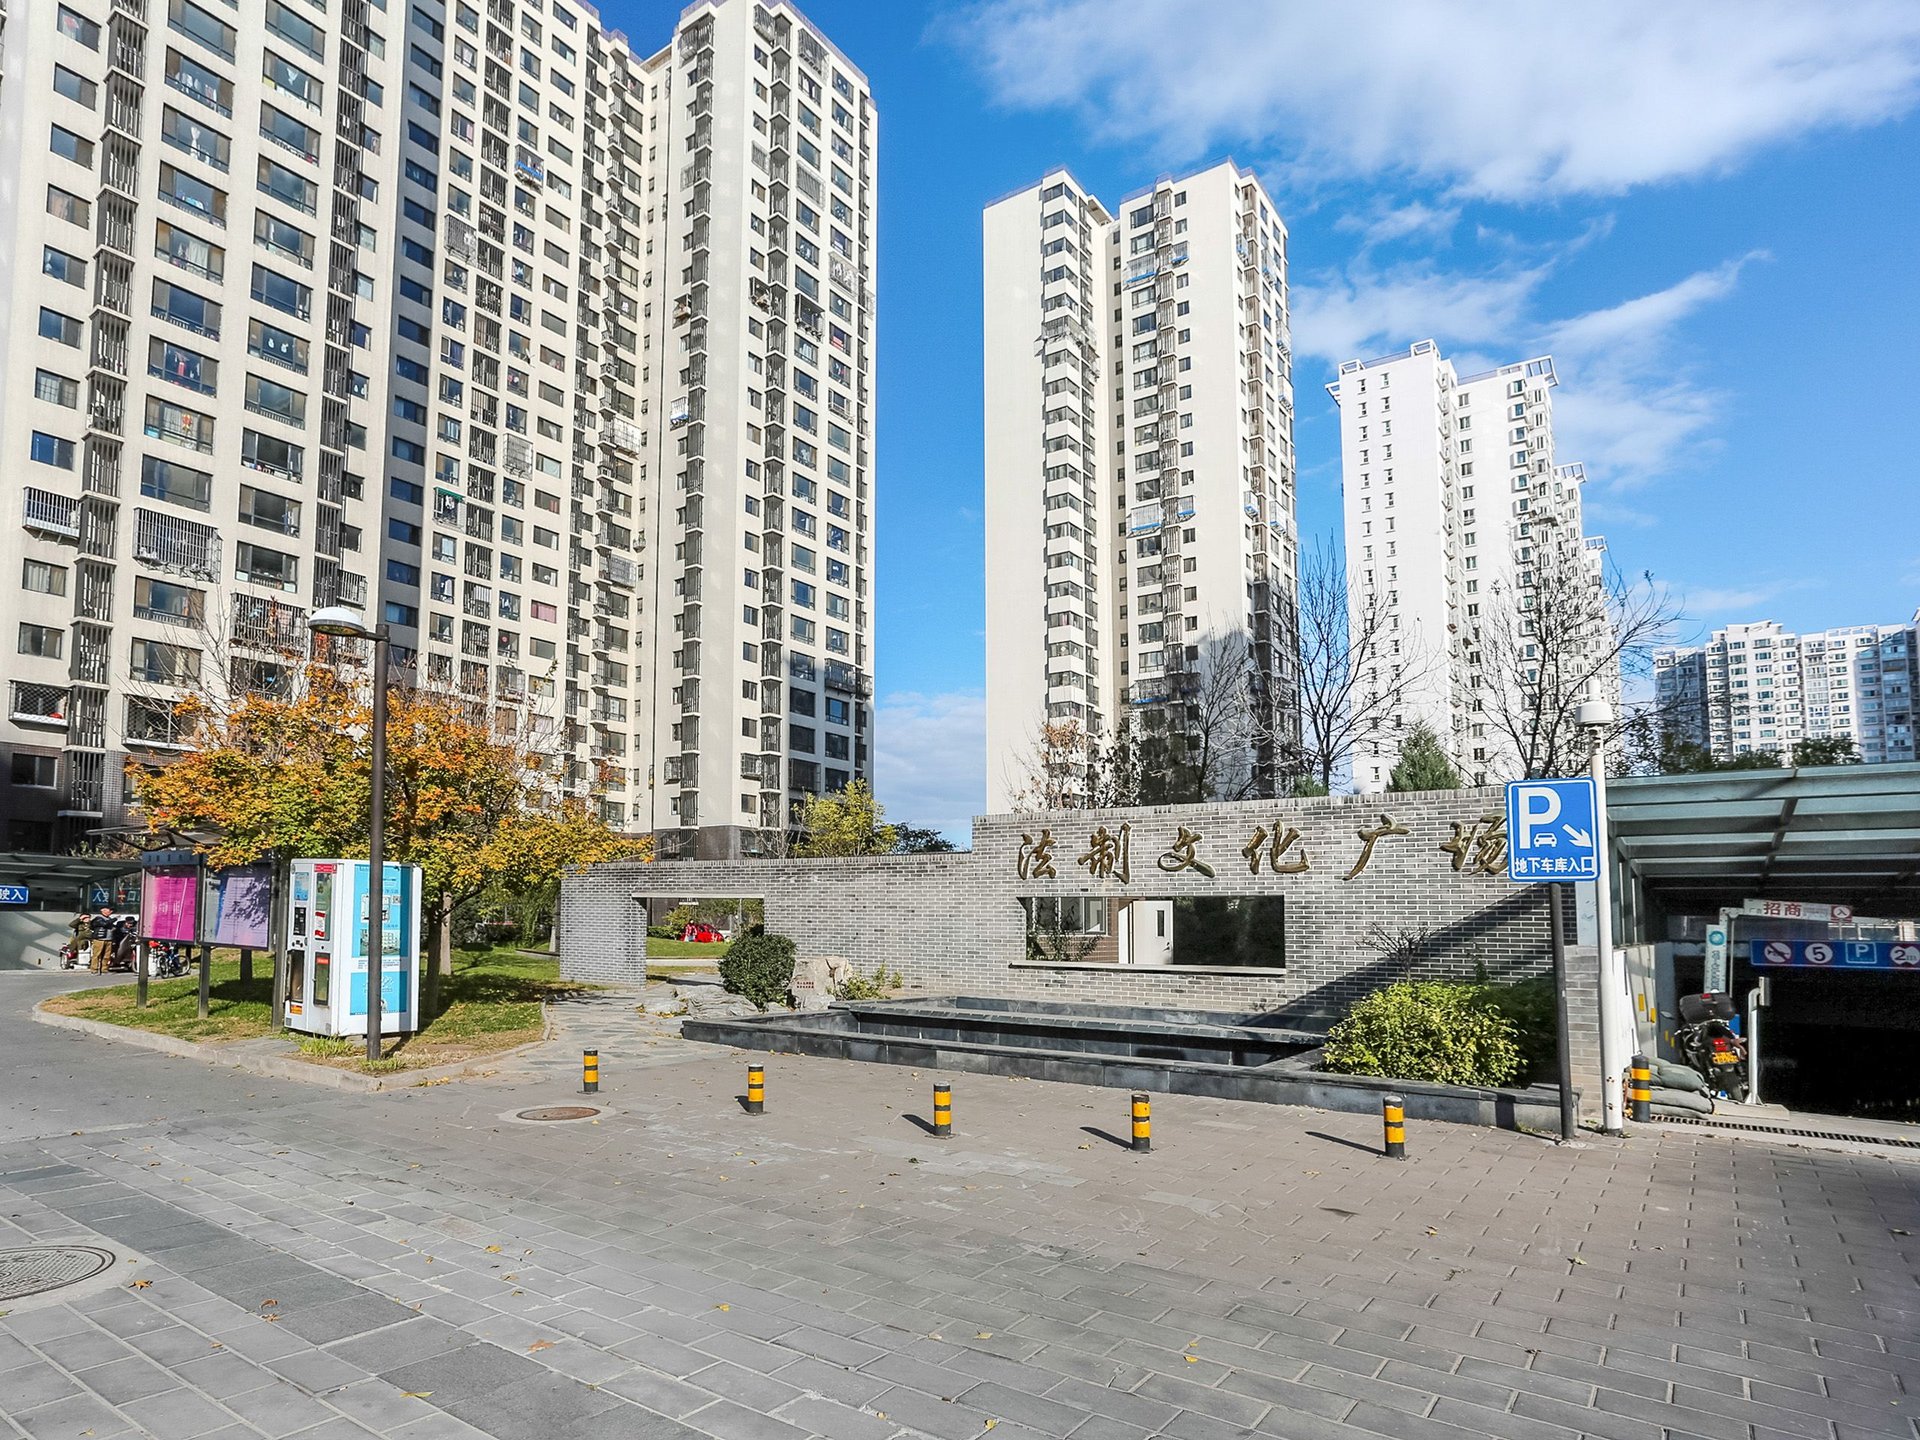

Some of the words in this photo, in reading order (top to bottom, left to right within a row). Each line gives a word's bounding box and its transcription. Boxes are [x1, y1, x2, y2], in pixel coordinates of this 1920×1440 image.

[1518, 787, 1561, 849] P
[1017, 811, 1508, 885] 法制文化广场
[1514, 856, 1594, 873] 地下车库入口
[1763, 901, 1802, 917] 招商
[1812, 946, 1826, 962] 5
[1855, 943, 1869, 958] P
